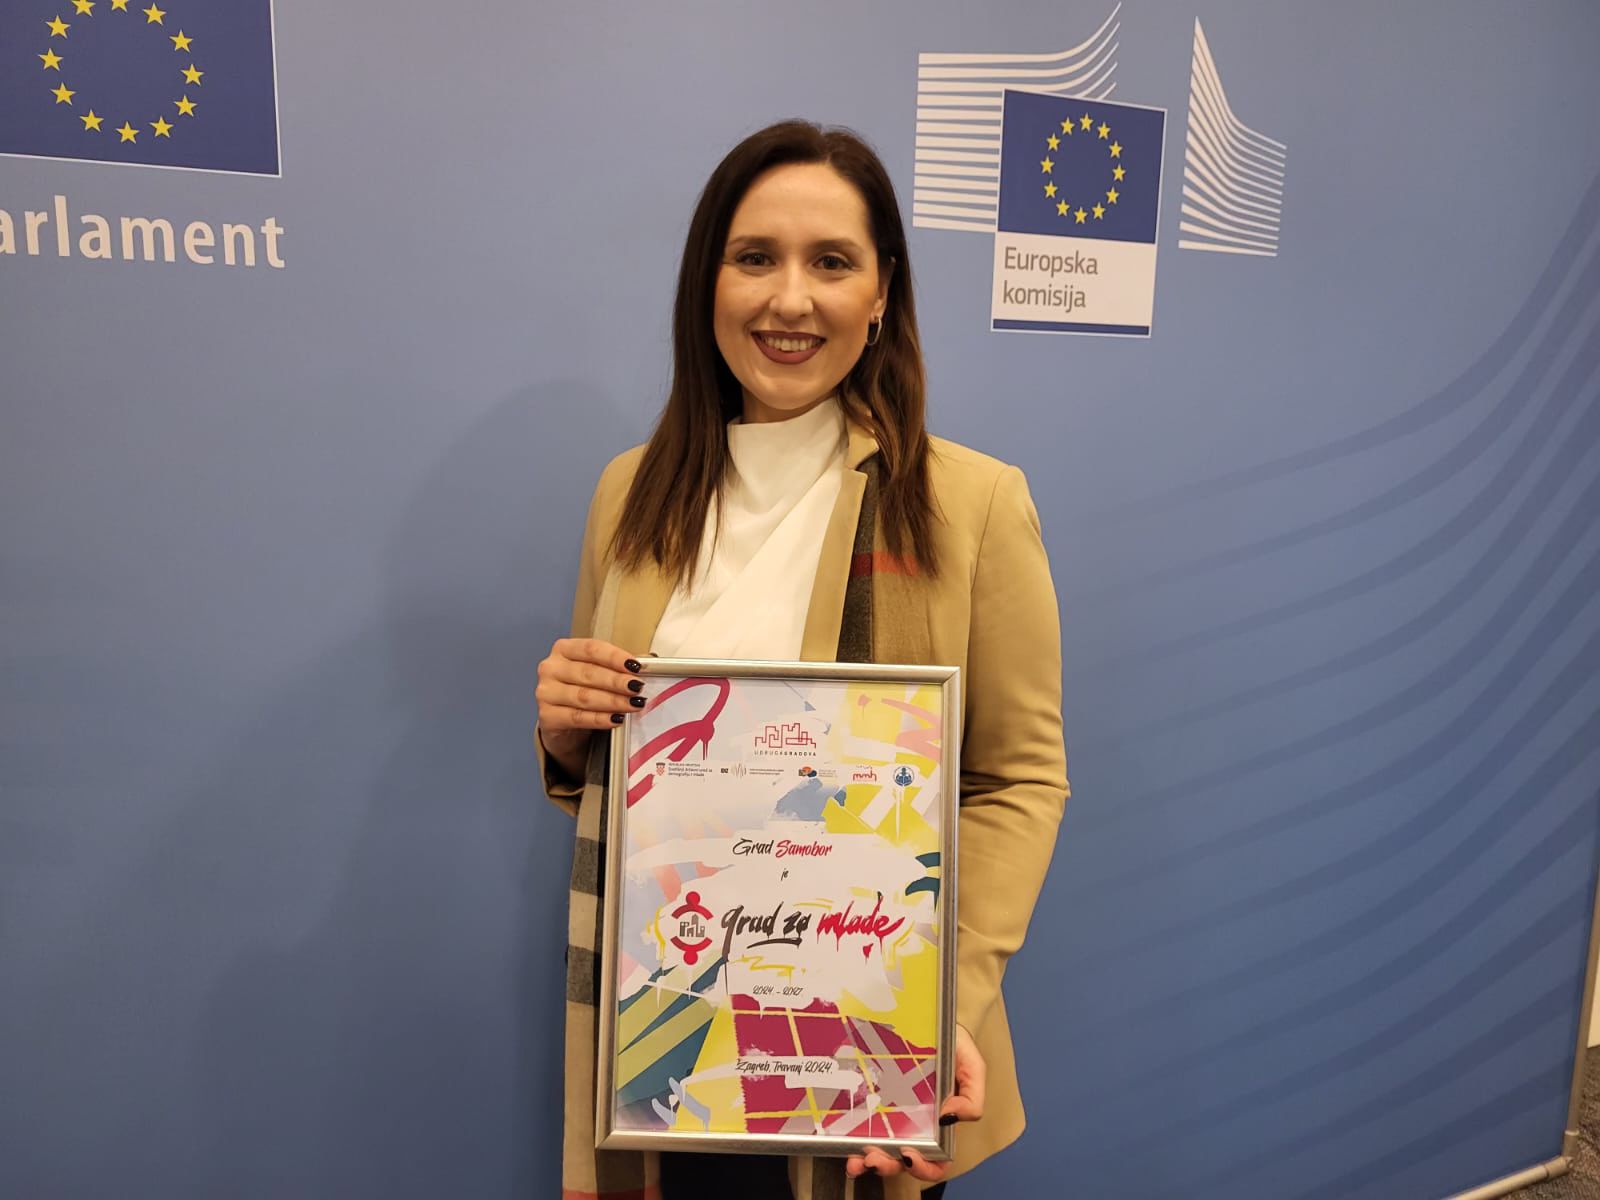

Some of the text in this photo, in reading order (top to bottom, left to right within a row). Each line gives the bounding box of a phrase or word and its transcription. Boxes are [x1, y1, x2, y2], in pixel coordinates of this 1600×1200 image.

[1004, 246, 1098, 278] Europska
[1002, 280, 1086, 313] komisija
[732, 838, 833, 858] Grad Samobor
[780, 867, 789, 881] je
[783, 911, 812, 939] za
[816, 894, 906, 950] mlade
